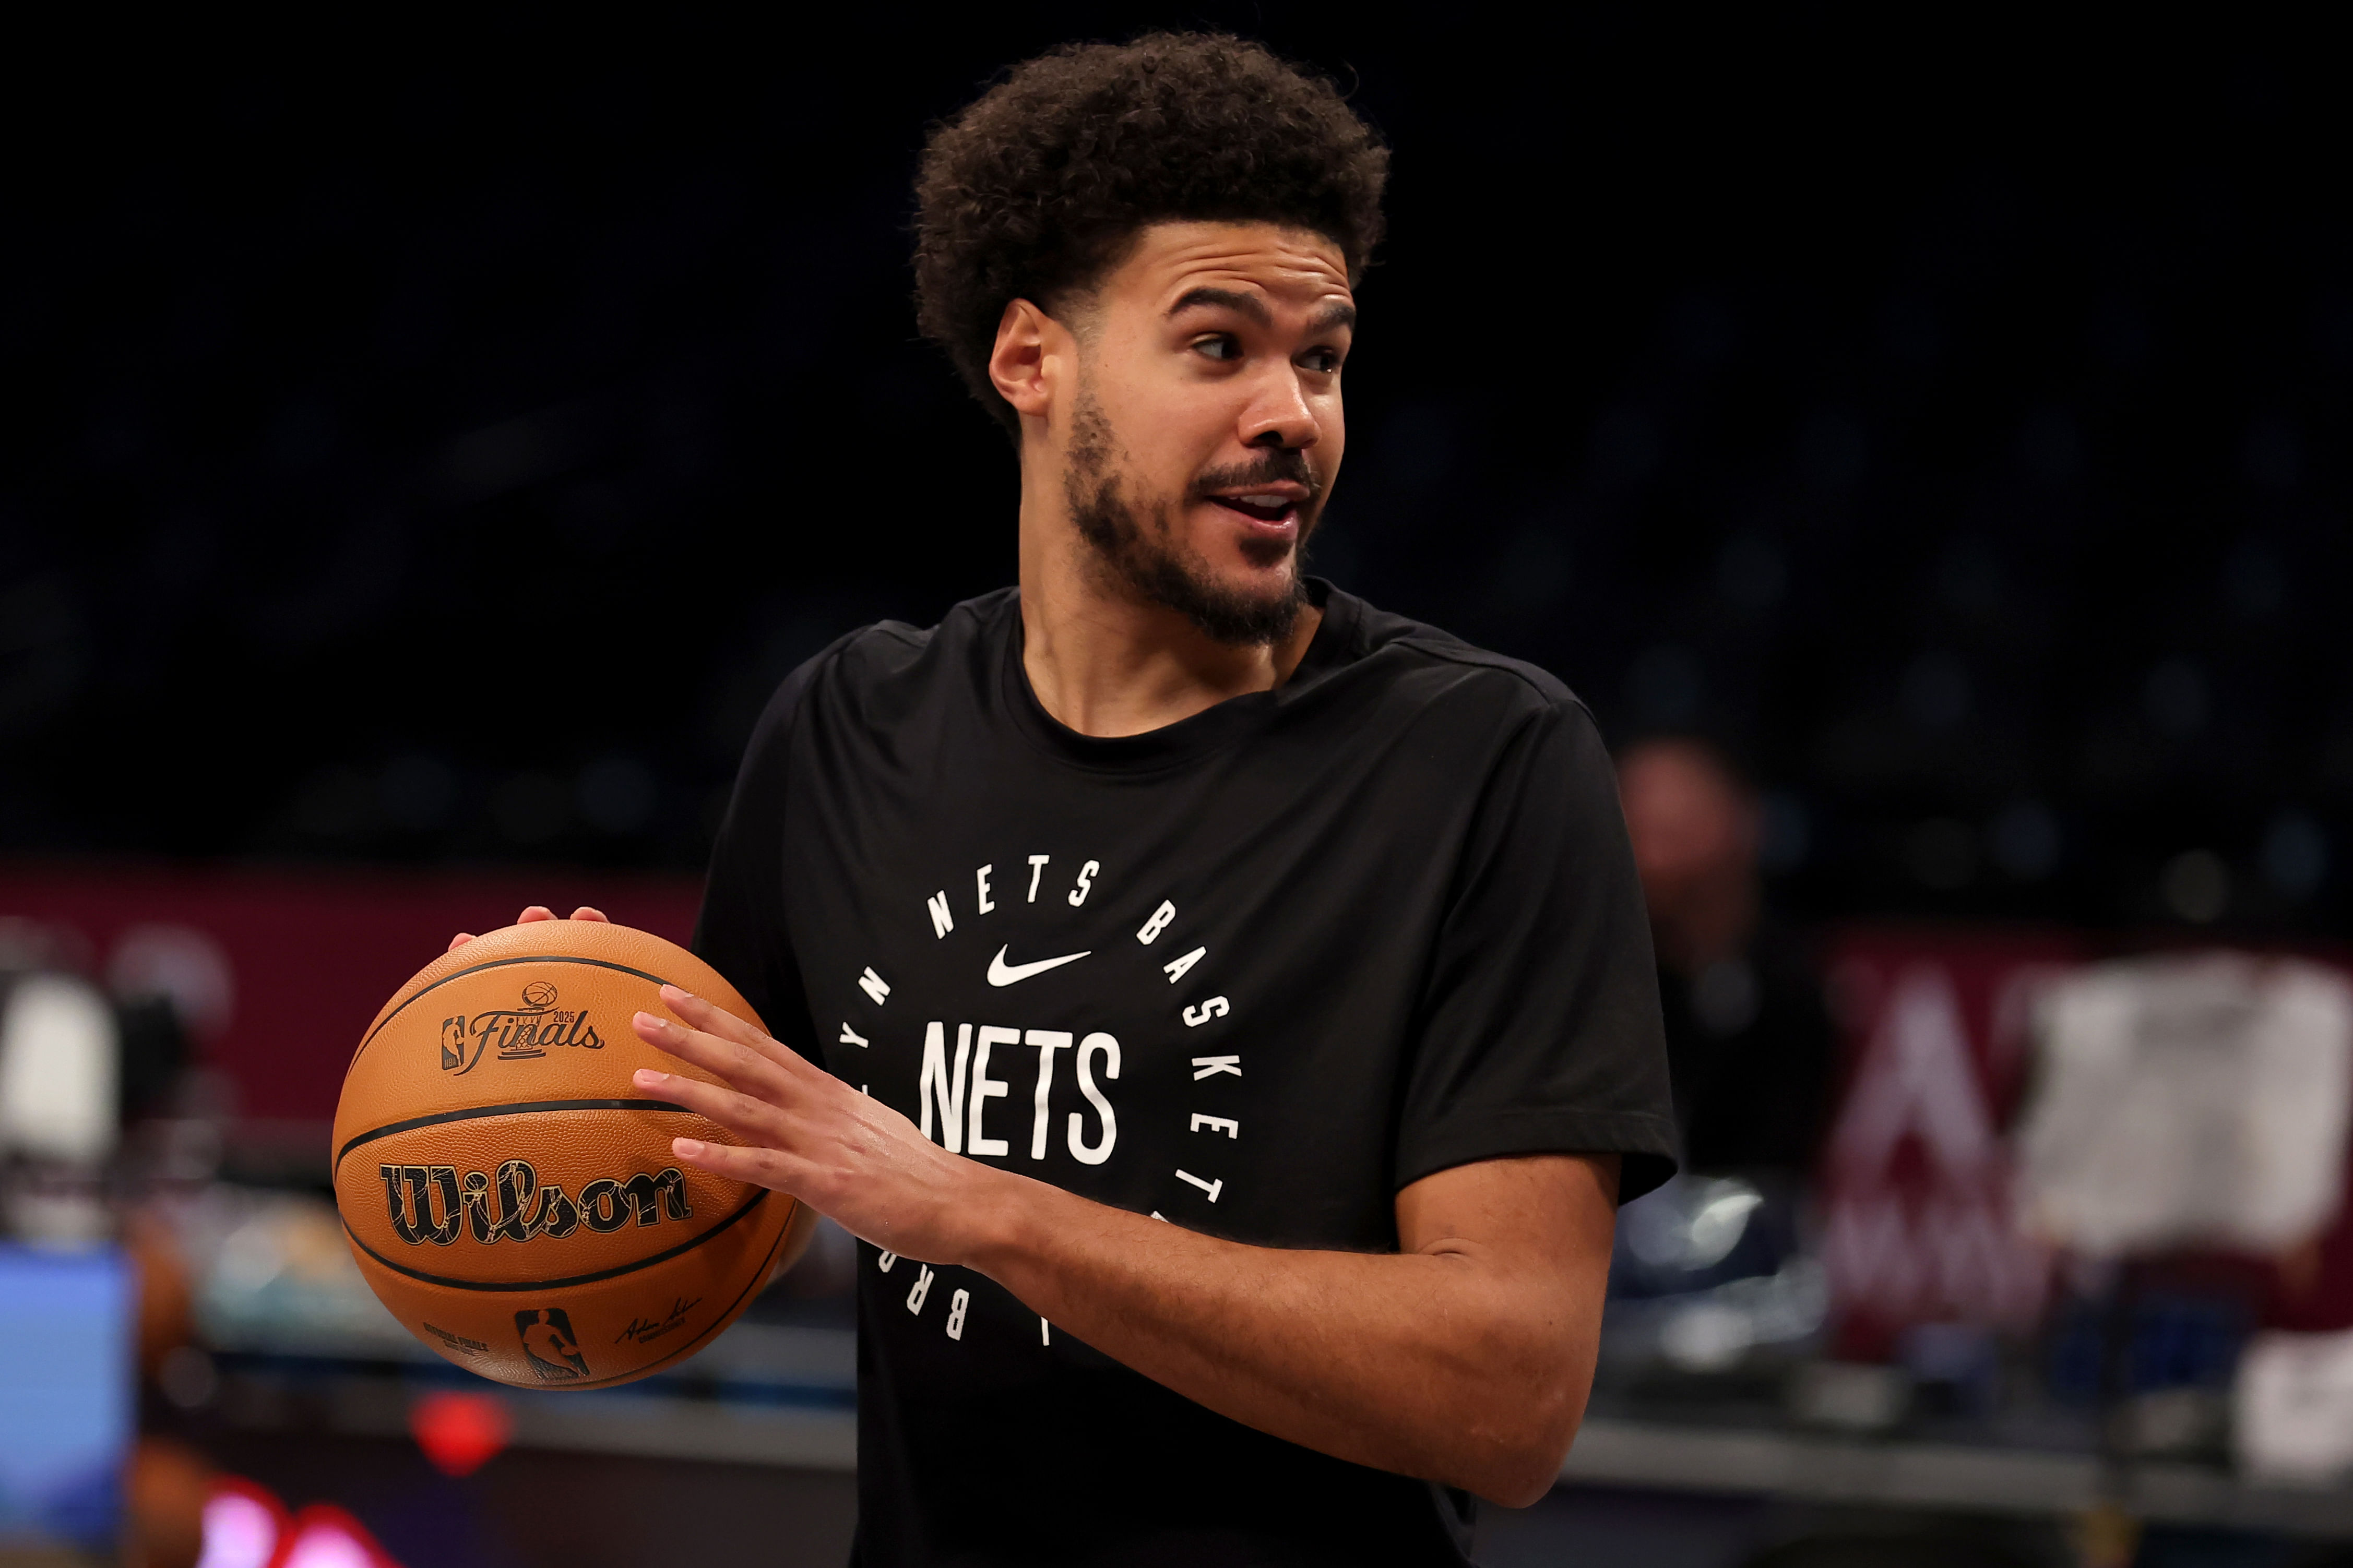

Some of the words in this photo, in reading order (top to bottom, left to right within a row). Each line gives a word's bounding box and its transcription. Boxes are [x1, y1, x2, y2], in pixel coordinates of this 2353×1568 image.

[927, 854, 1100, 939] NETS
[454, 1007, 605, 1076] Finals
[553, 1011, 575, 1023] 2025
[920, 1021, 1121, 1165] NETS
[379, 1159, 693, 1246] Wilson
